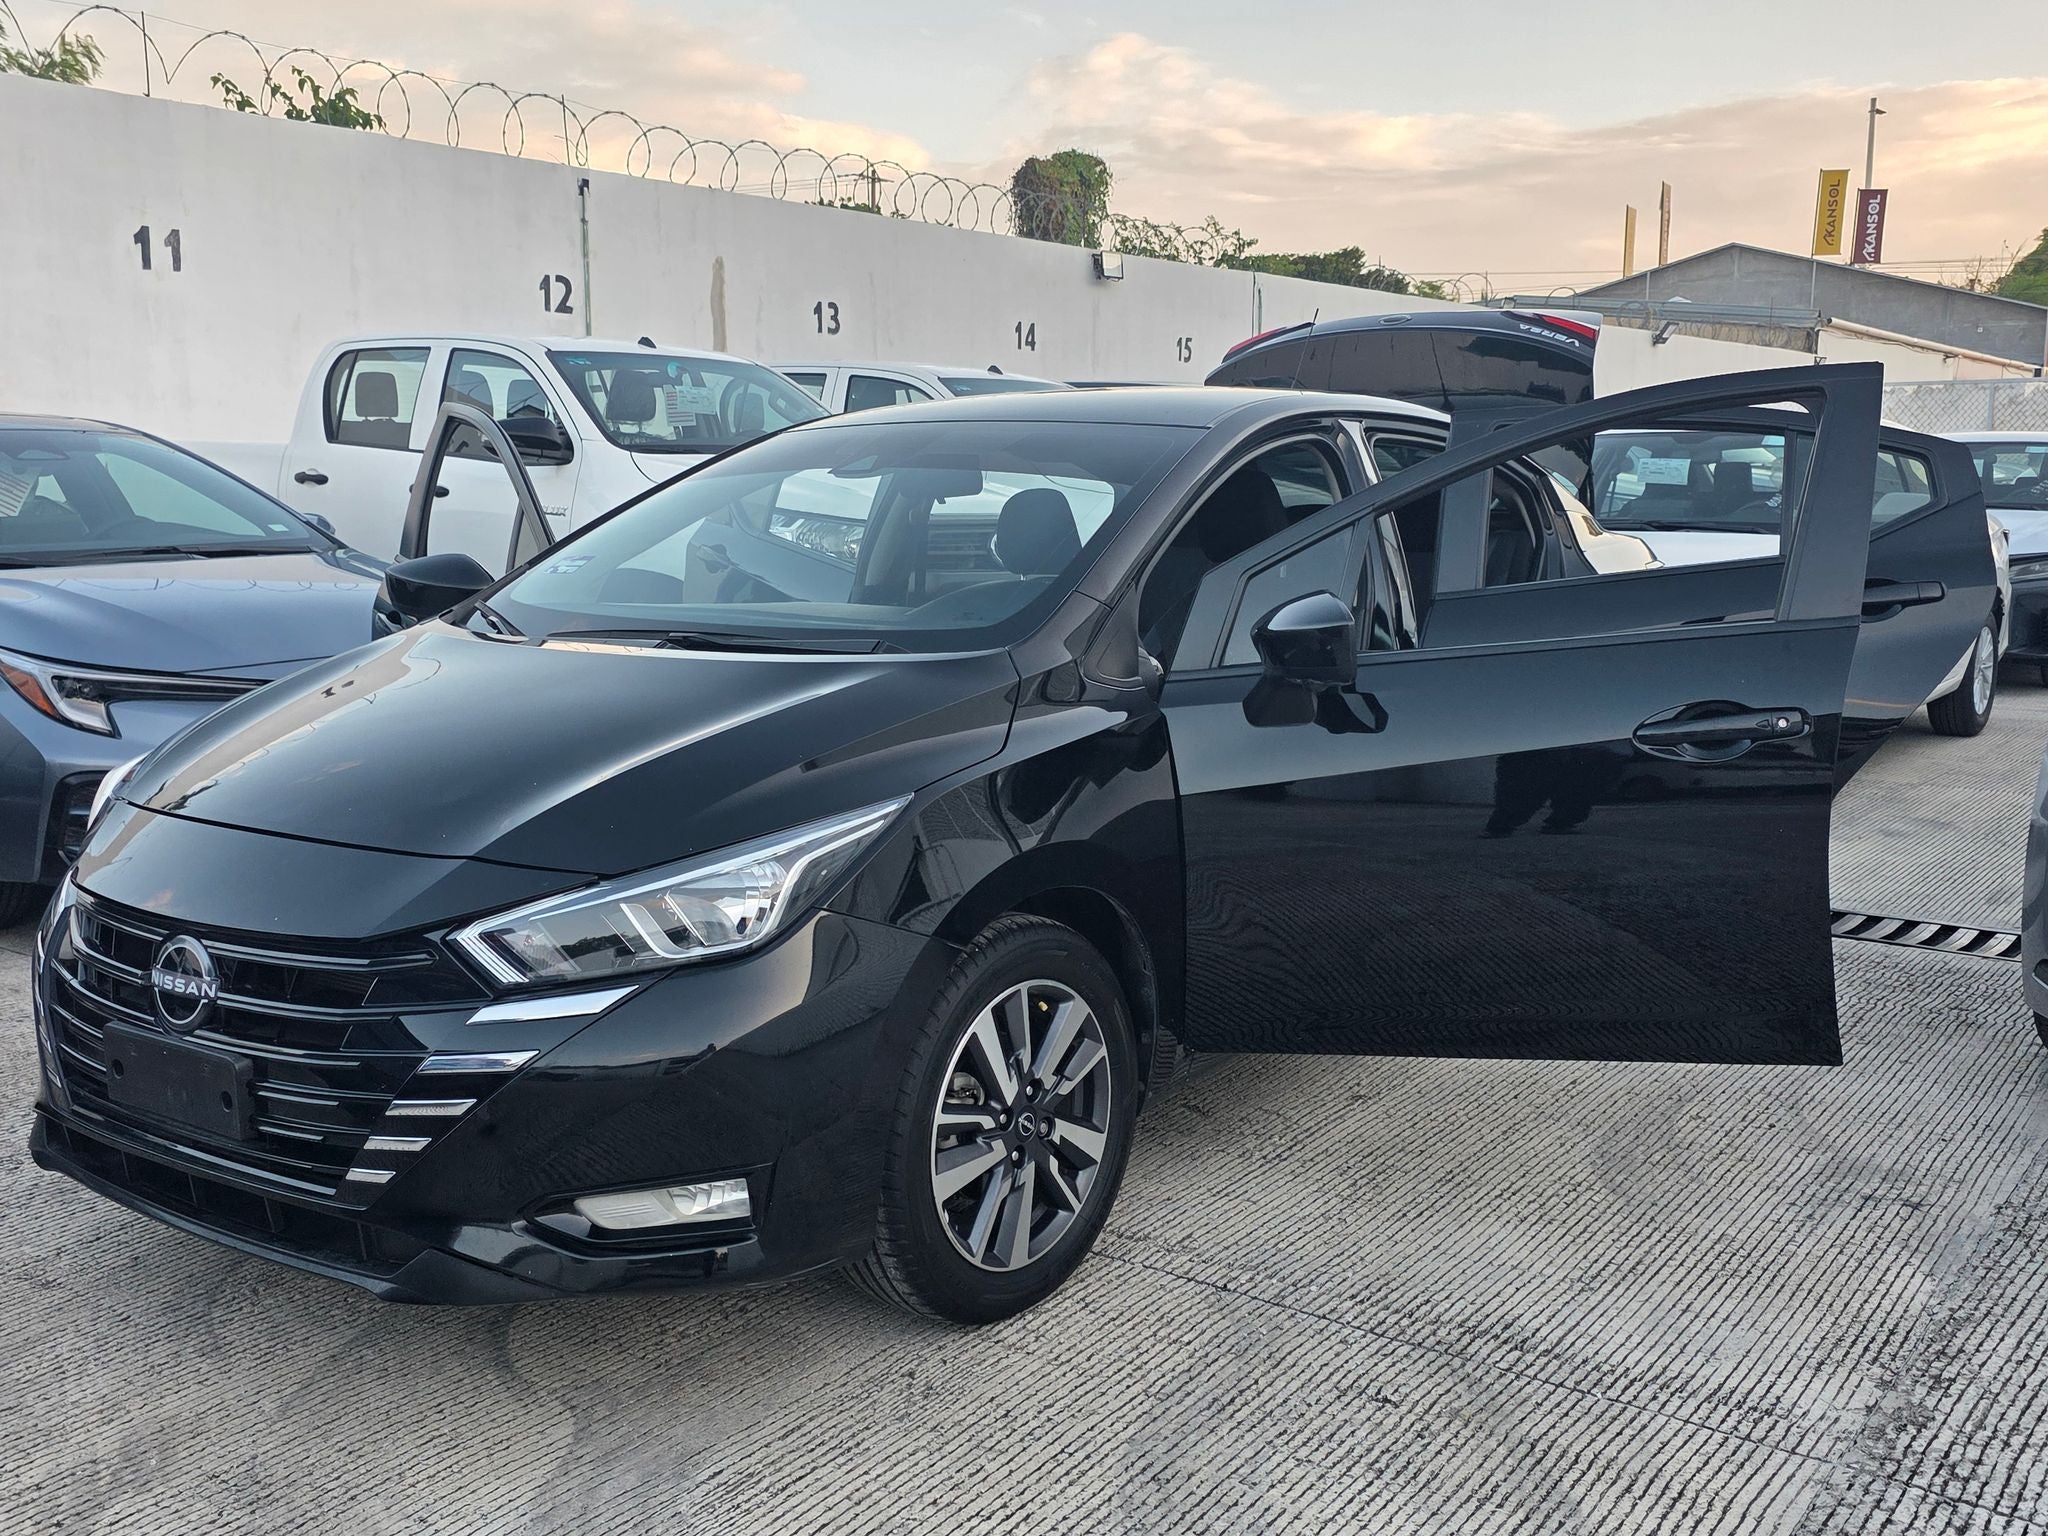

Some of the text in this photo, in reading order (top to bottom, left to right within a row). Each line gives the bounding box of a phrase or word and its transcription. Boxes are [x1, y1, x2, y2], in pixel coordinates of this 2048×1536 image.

[1824, 178, 1841, 239] KANSOL
[1864, 194, 1881, 253] KANSOL
[133, 225, 182, 272] 11
[539, 274, 574, 315] 12
[813, 301, 841, 335] 13
[1519, 323, 1580, 347] VERSA
[1015, 321, 1037, 351] 14
[1176, 336, 1193, 363] 15
[151, 968, 217, 998] NISSAN
